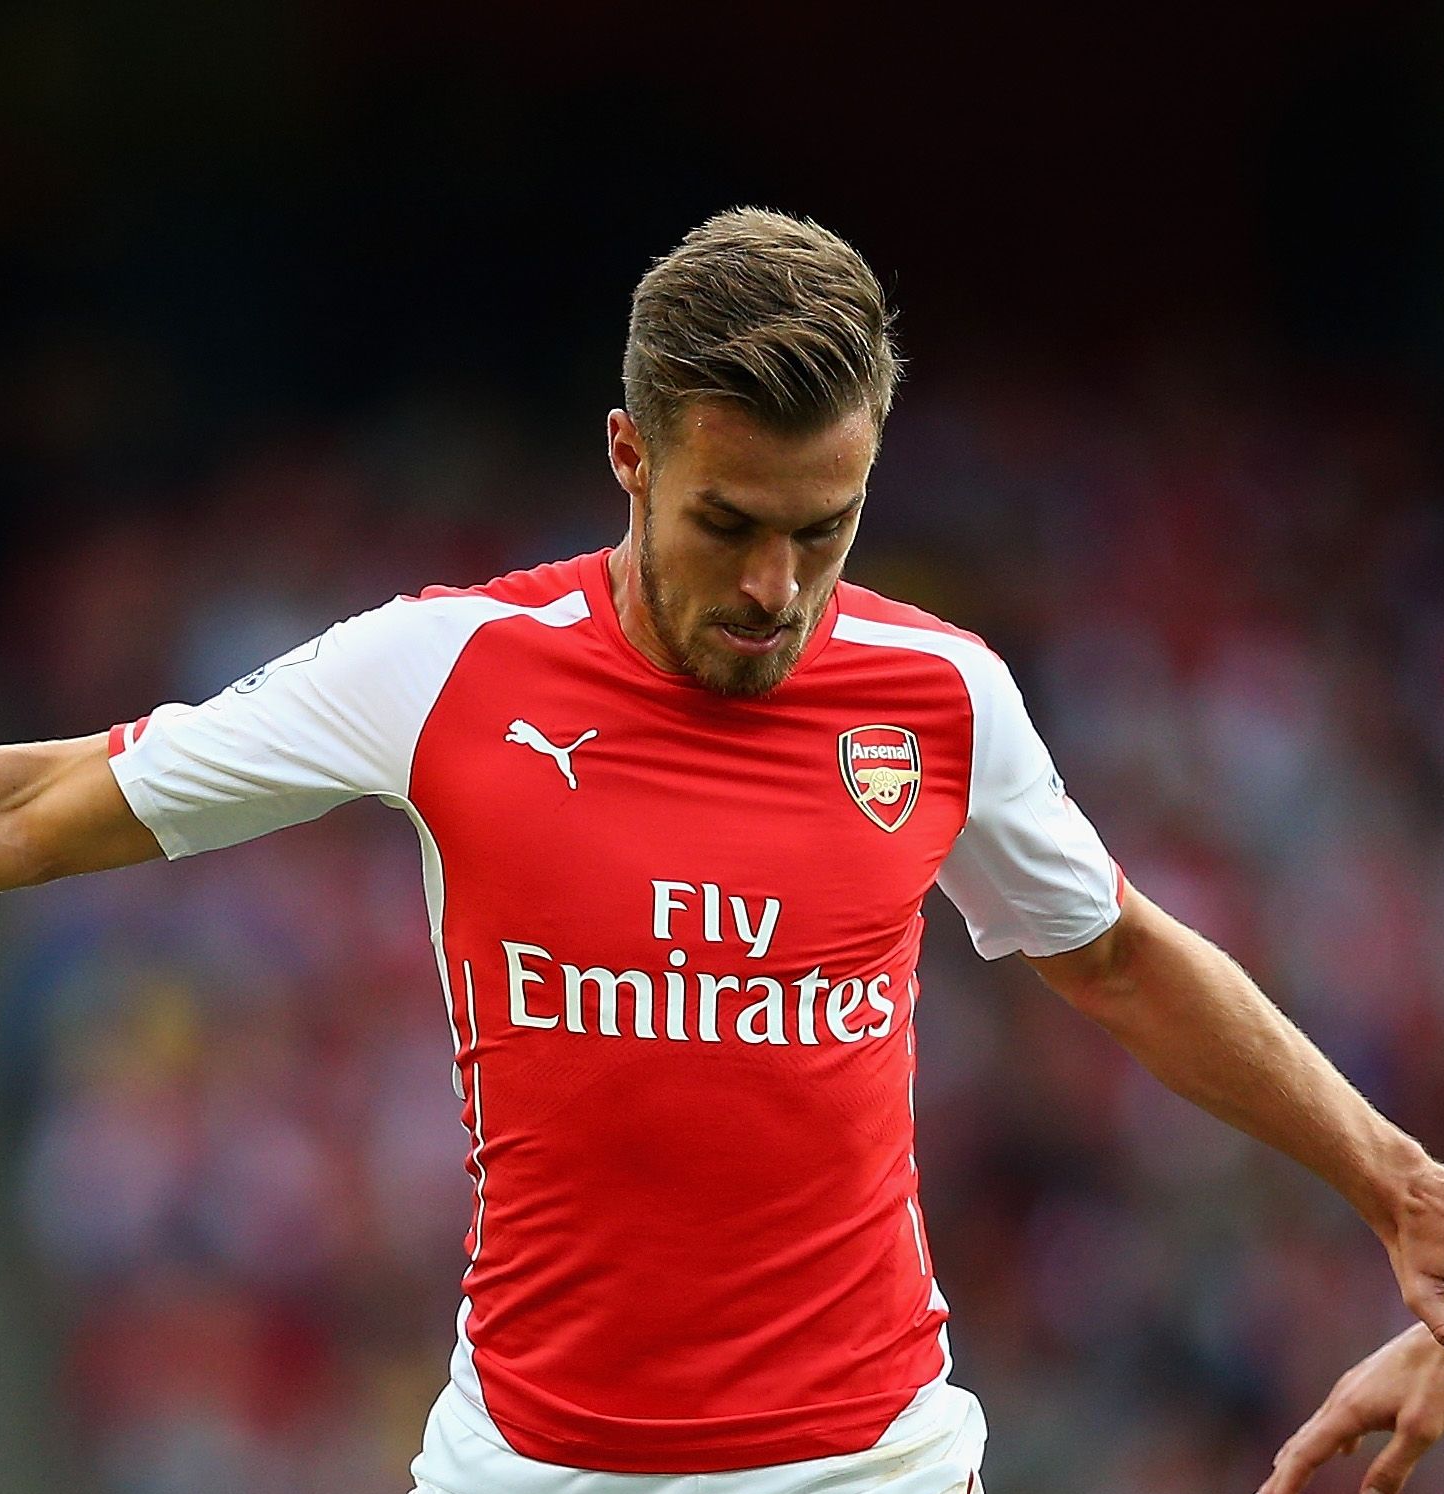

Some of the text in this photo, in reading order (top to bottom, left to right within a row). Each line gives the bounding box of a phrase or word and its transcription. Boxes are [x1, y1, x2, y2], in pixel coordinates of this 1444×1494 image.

[851, 742, 911, 760] Arsenal
[651, 879, 781, 959] Fly
[500, 940, 895, 1046] Emirates
